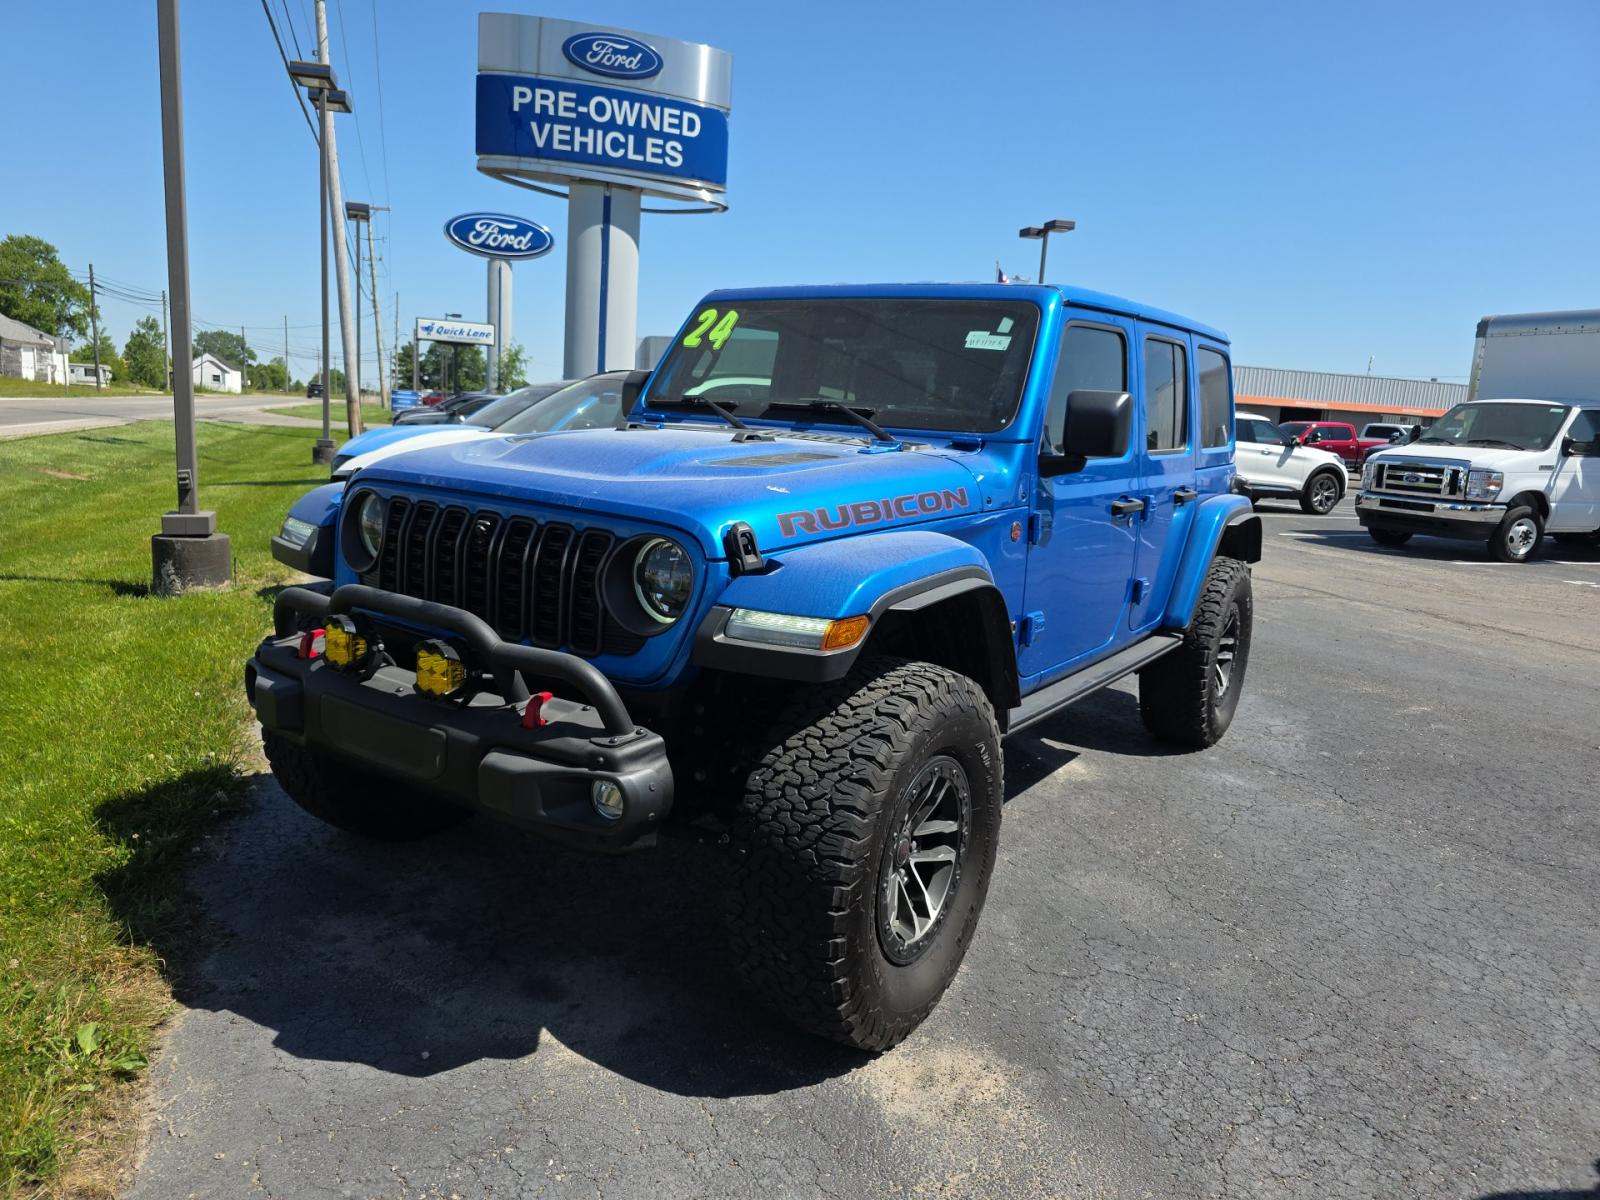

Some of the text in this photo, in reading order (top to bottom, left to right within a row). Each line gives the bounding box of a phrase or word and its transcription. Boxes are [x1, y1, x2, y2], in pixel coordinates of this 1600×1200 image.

[586, 40, 642, 69] Ford
[513, 85, 701, 138] PRE-OWNED
[530, 121, 683, 167] VEHICLES
[468, 219, 534, 250] Ford
[436, 326, 492, 339] Quick Lane
[683, 308, 739, 350] 24
[776, 487, 969, 538] RUBICON
